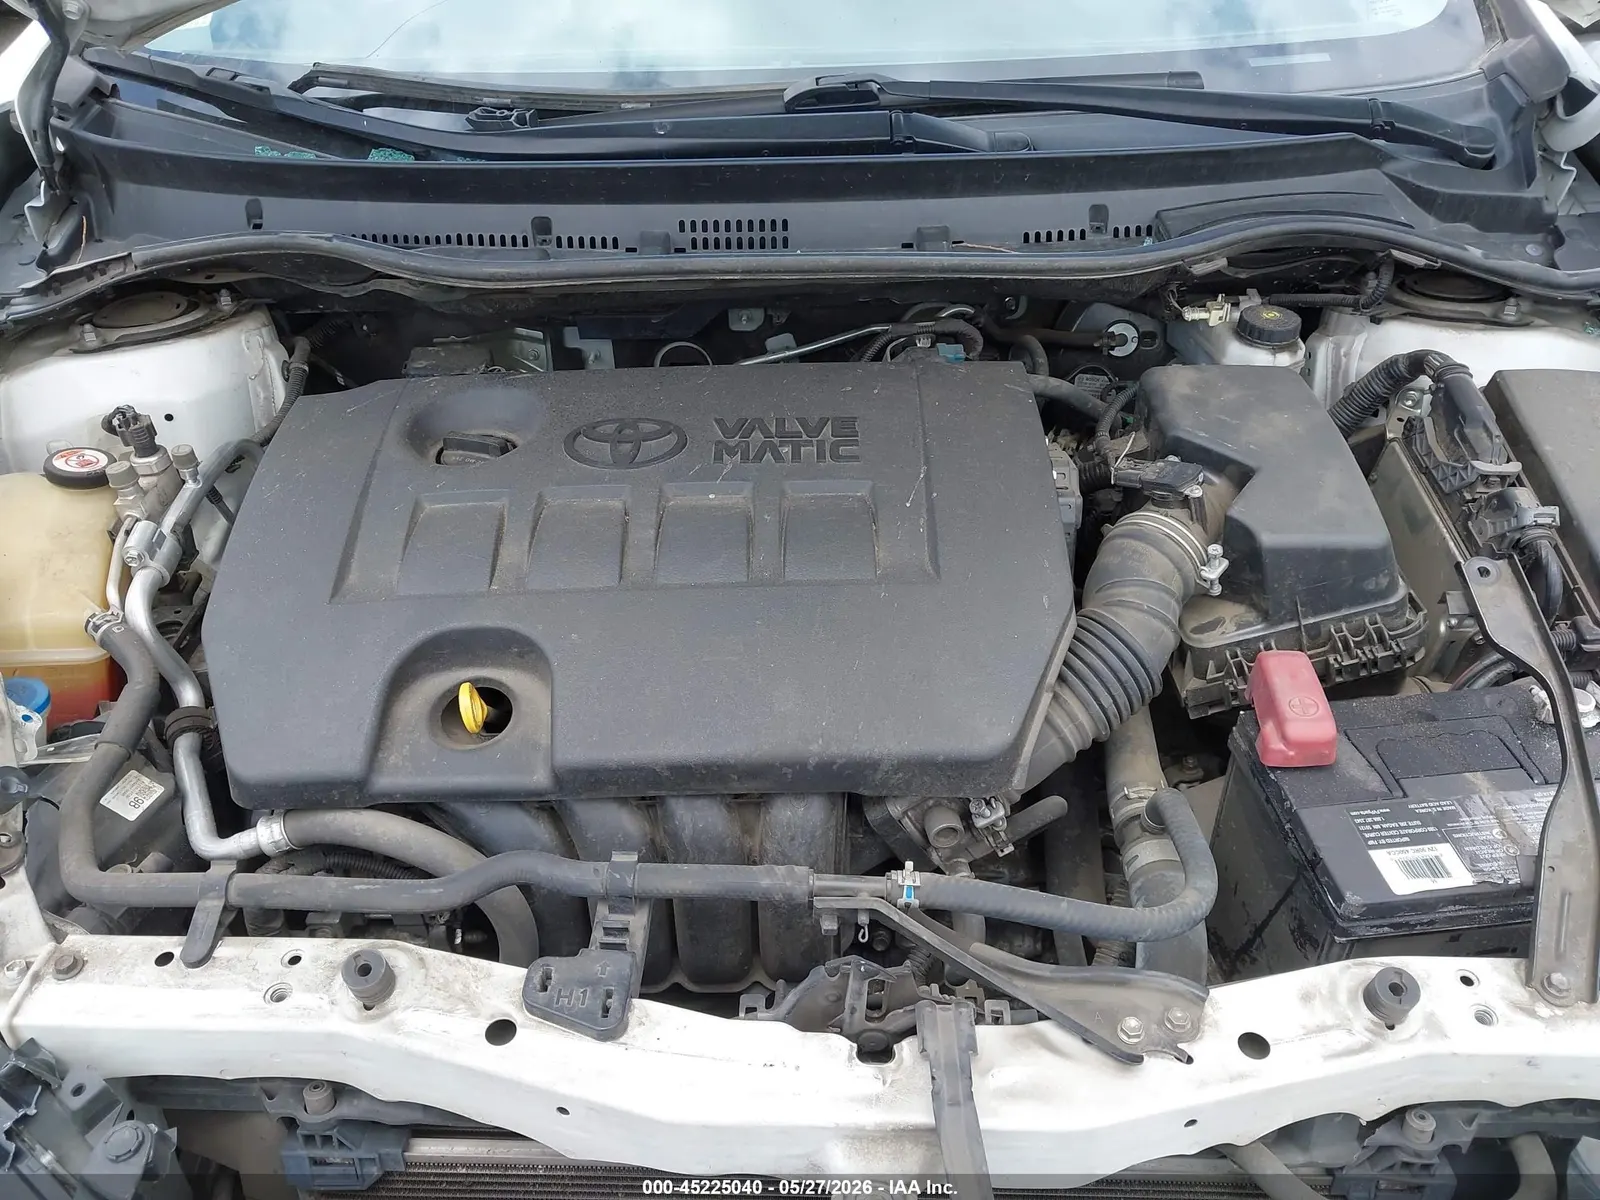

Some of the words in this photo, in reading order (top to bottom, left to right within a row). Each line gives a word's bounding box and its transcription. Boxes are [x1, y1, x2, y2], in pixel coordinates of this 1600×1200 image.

[714, 416, 859, 439] VALVE
[713, 439, 861, 464] MATIC
[1398, 827, 1427, 835] CORPORATE
[1385, 836, 1411, 844] IMPORTED
[555, 987, 590, 1007] H1
[1094, 1011, 1104, 1024] A
